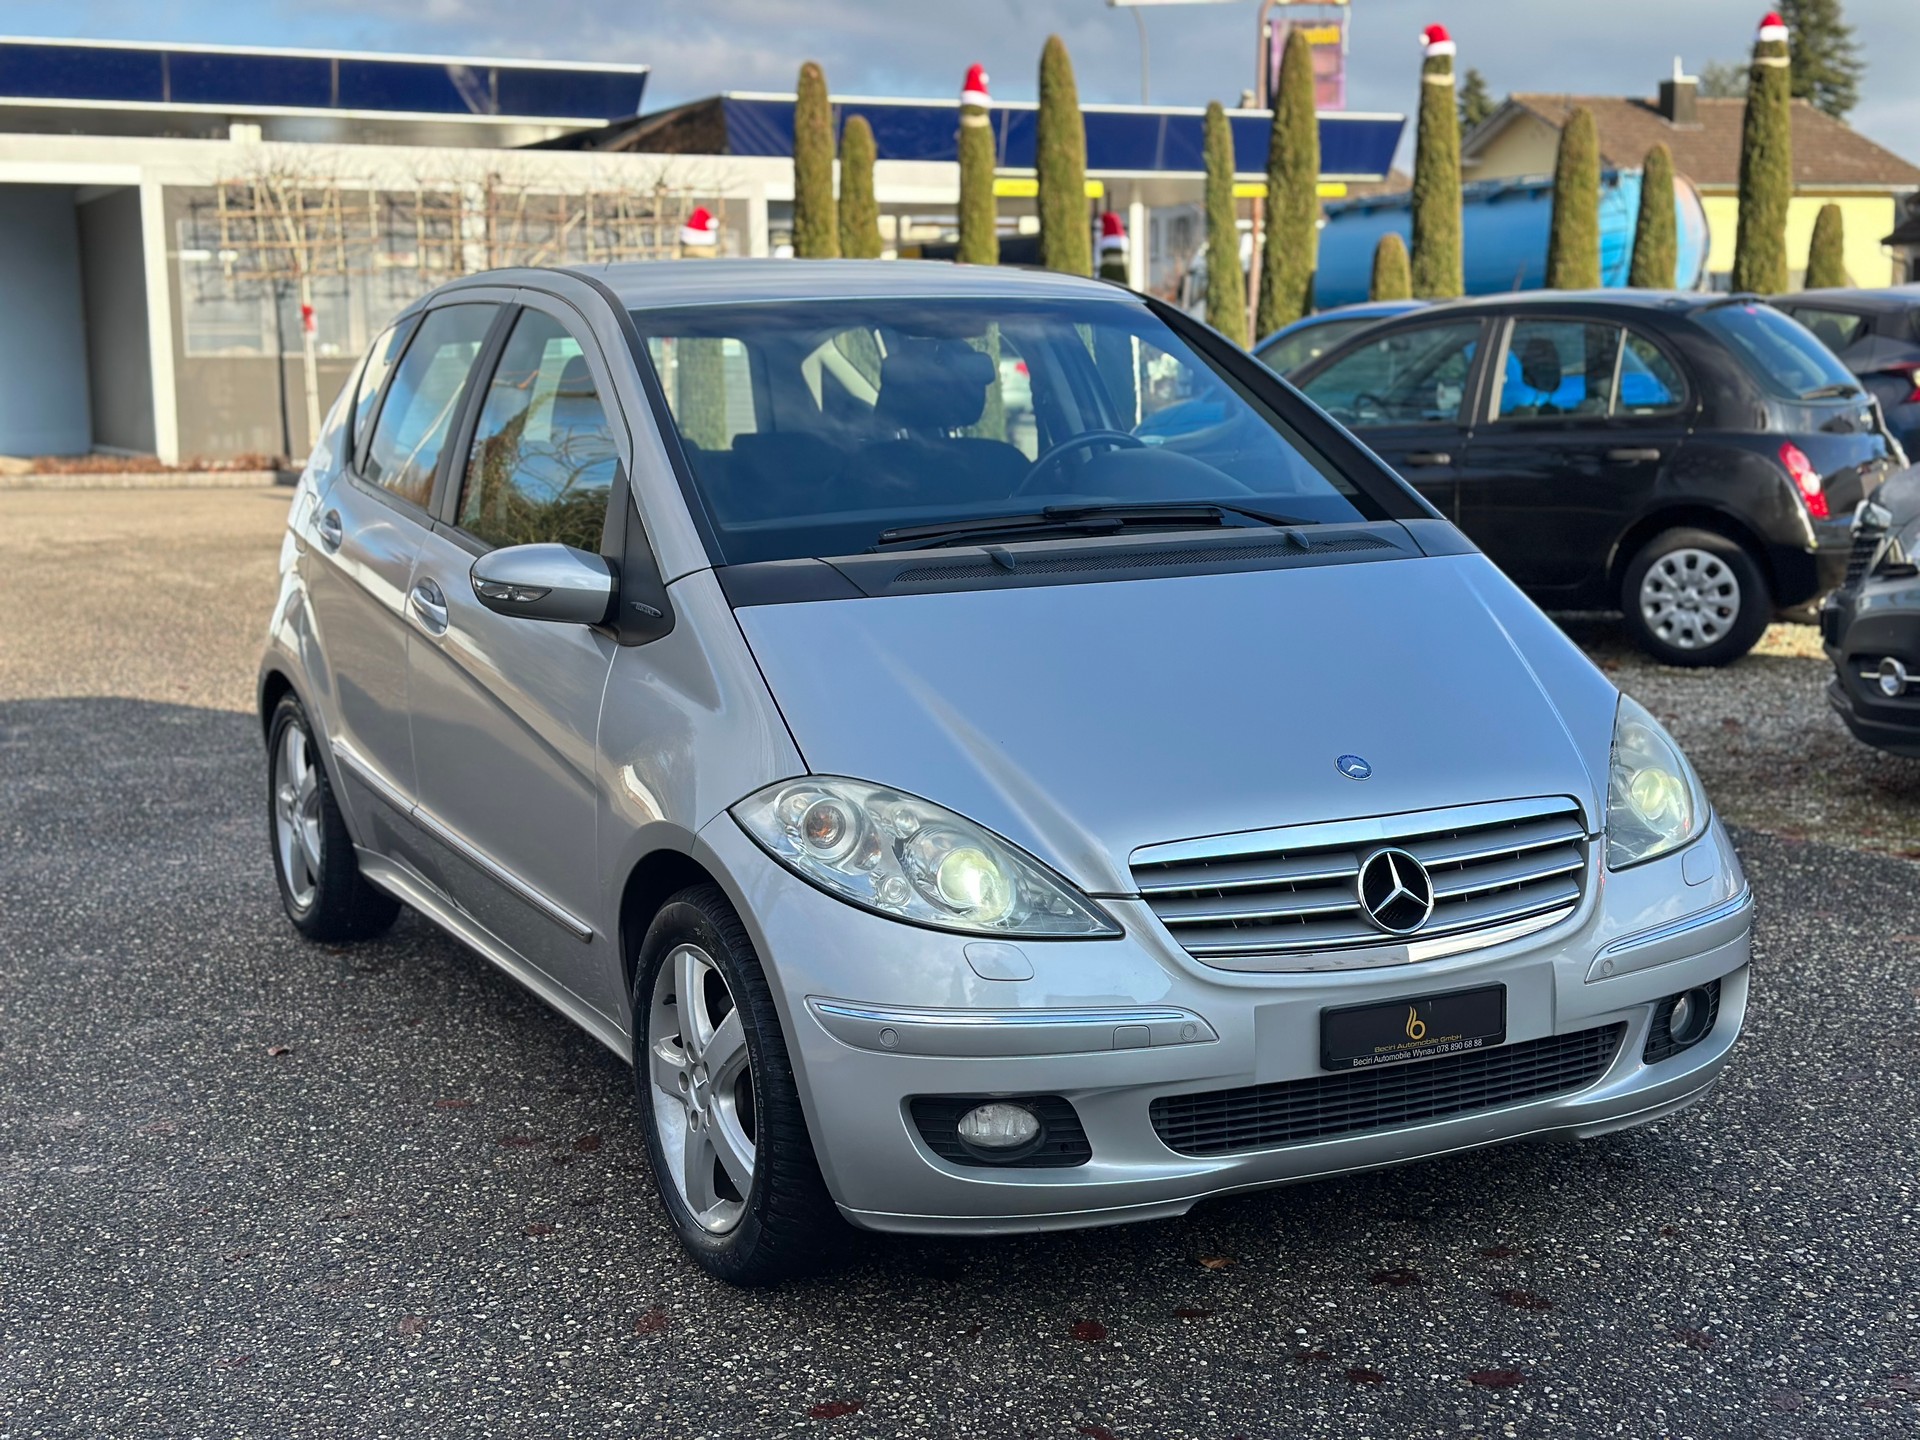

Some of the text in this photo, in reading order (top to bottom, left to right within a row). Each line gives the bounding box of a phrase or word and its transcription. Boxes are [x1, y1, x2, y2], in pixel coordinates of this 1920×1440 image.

[1353, 1038, 1483, 1067] Beciri Automobile Wynau 078 890 68 88
[1374, 1033, 1462, 1053] Beciri Automobile GmbH
